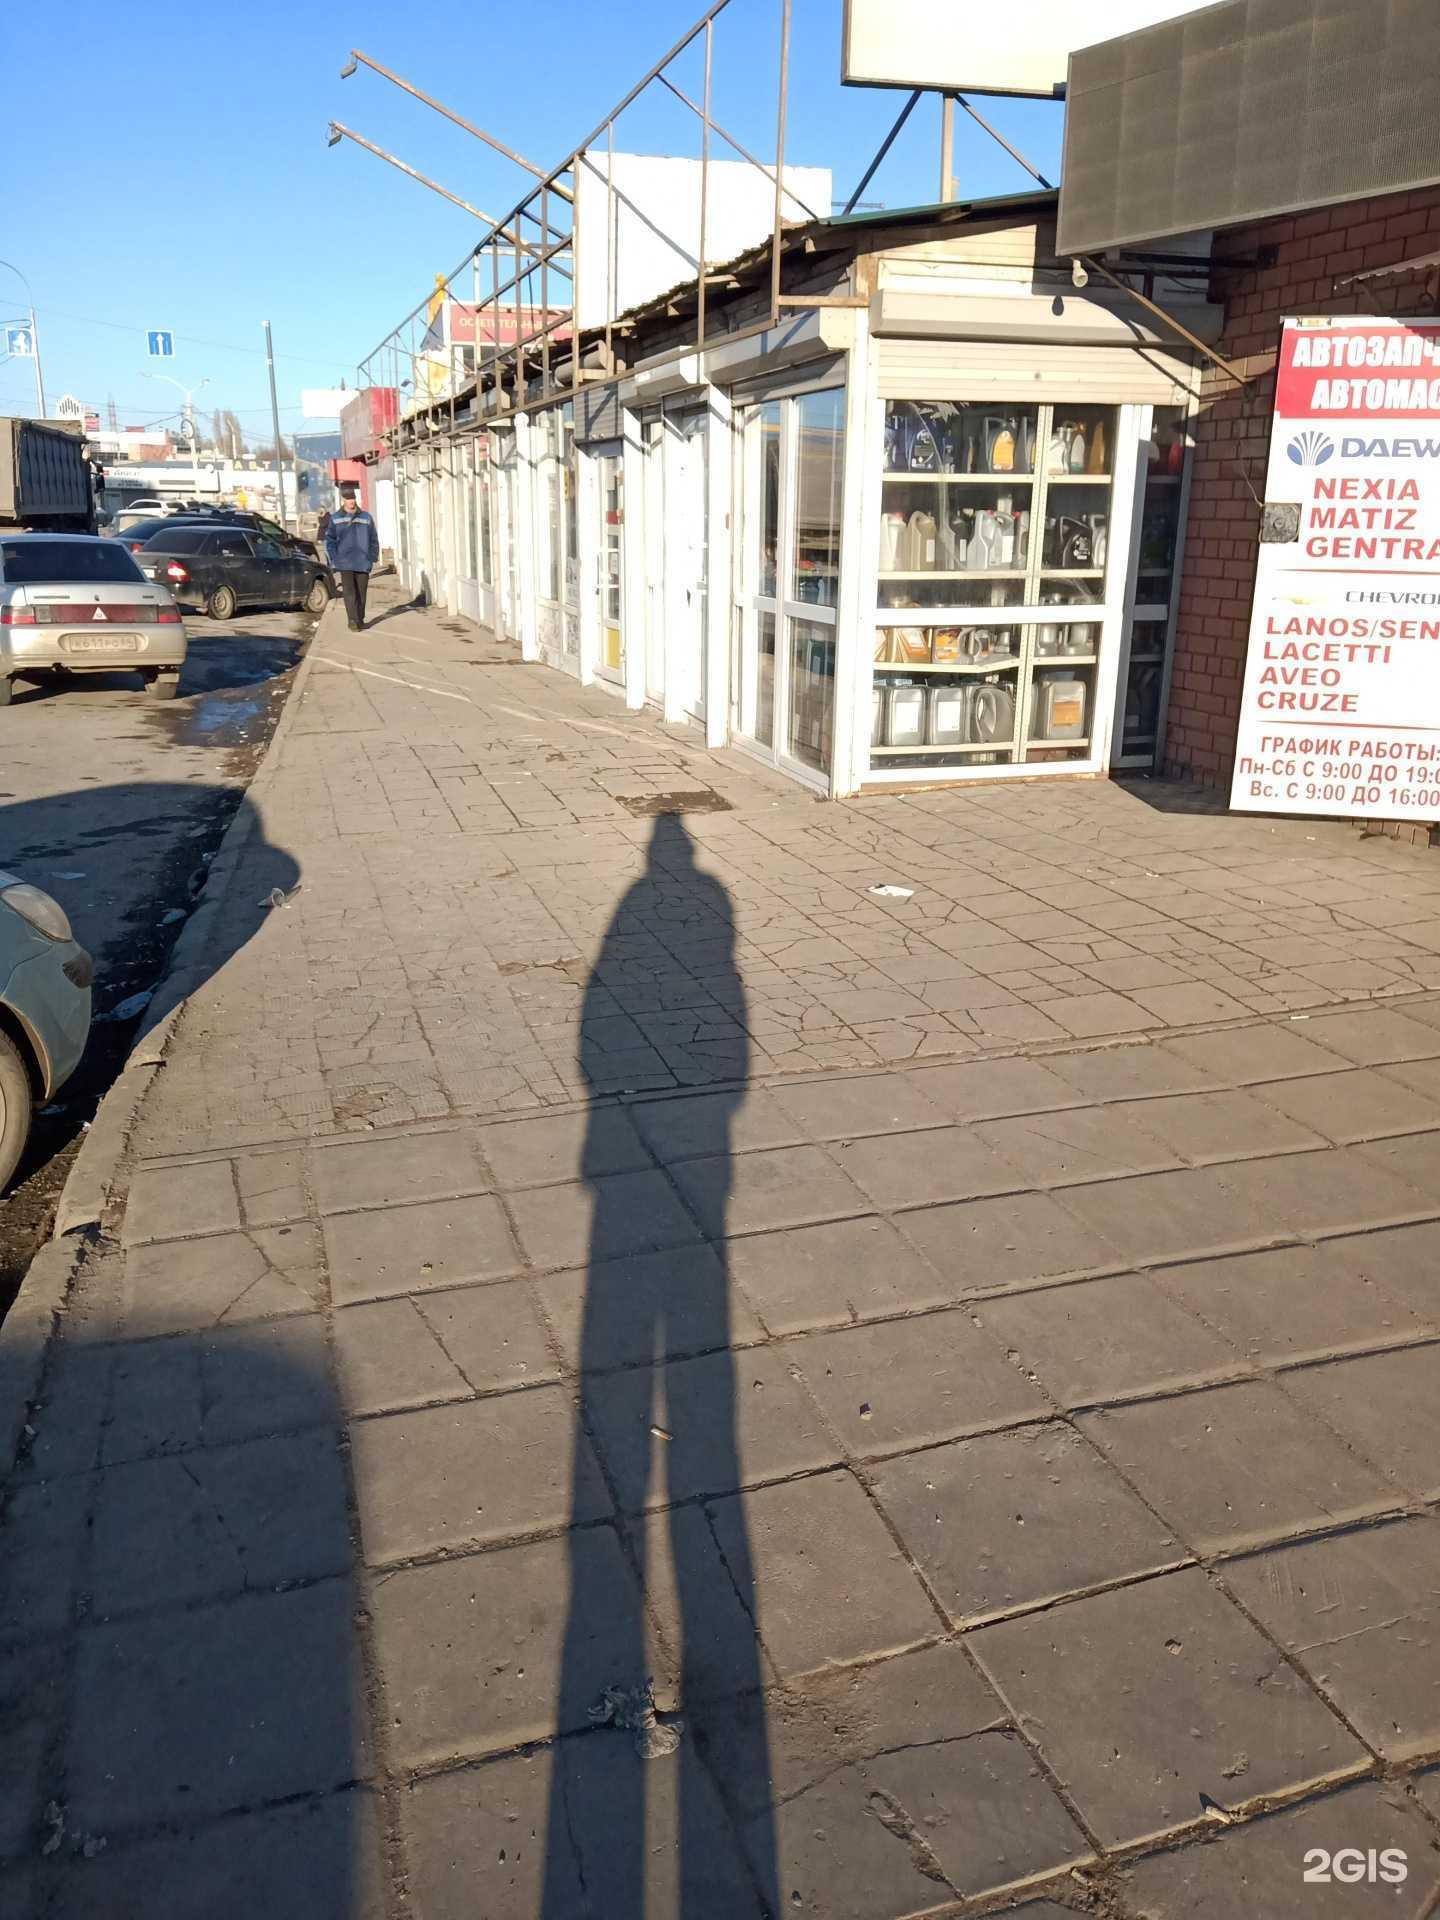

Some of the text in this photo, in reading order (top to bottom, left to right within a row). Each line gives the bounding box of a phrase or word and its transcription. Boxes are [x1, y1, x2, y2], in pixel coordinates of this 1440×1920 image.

[1313, 478, 1420, 500] NEXIA
[1309, 508, 1417, 530] MATIZ
[1306, 537, 1440, 559] GENTRA
[1345, 590, 1440, 606] CHEVRO
[1266, 616, 1440, 640] LANOS/SEN
[1263, 641, 1391, 663] LACETTI
[1259, 666, 1341, 687] AVEO
[1257, 691, 1359, 712] CRUZE
[1261, 736, 1343, 756] ГРАФИК
[1239, 758, 1296, 776] Пн-Сб
[1303, 761, 1315, 777] С
[1322, 762, 1362, 779] 9:00
[1368, 764, 1398, 784] ДО
[1250, 780, 1440, 807] Вс. С 9:00 ДО 16:00
